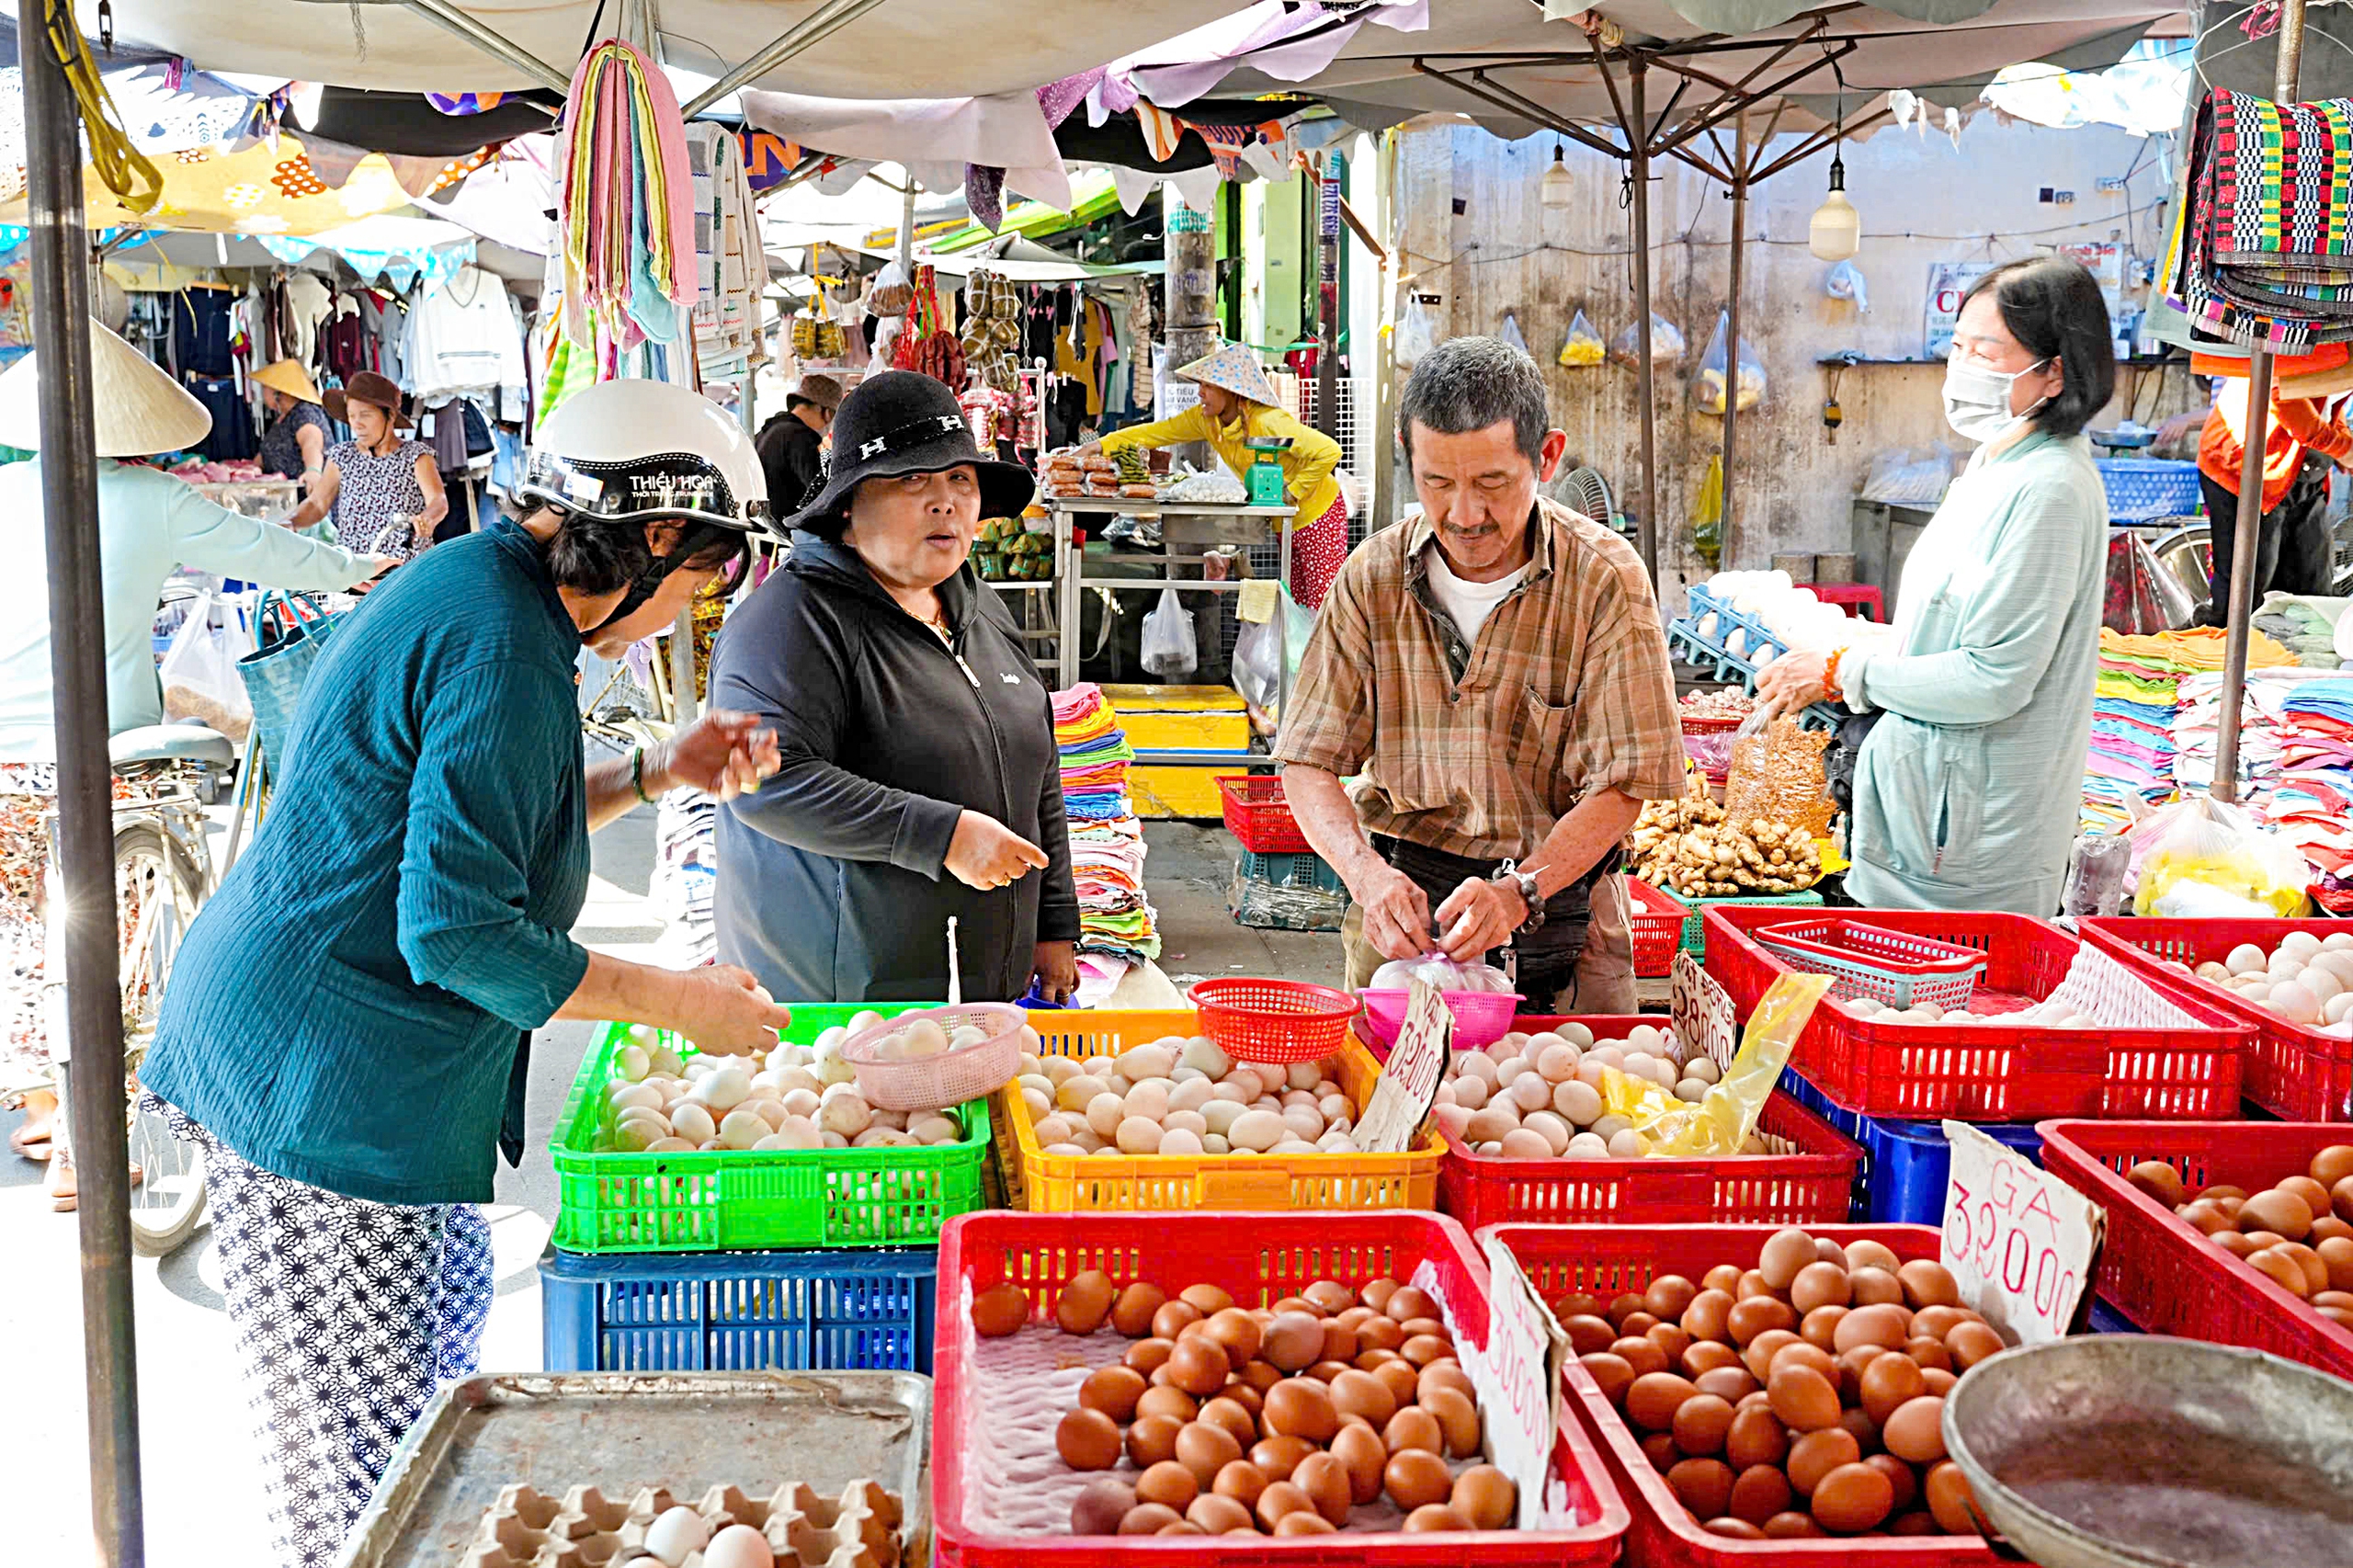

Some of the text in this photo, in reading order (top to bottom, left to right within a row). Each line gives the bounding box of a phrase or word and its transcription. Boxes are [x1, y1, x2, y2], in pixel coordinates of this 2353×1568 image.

[680, 475, 713, 490] HOA
[1673, 983, 1730, 1073] 28000
[1947, 1179, 2075, 1335] 32000
